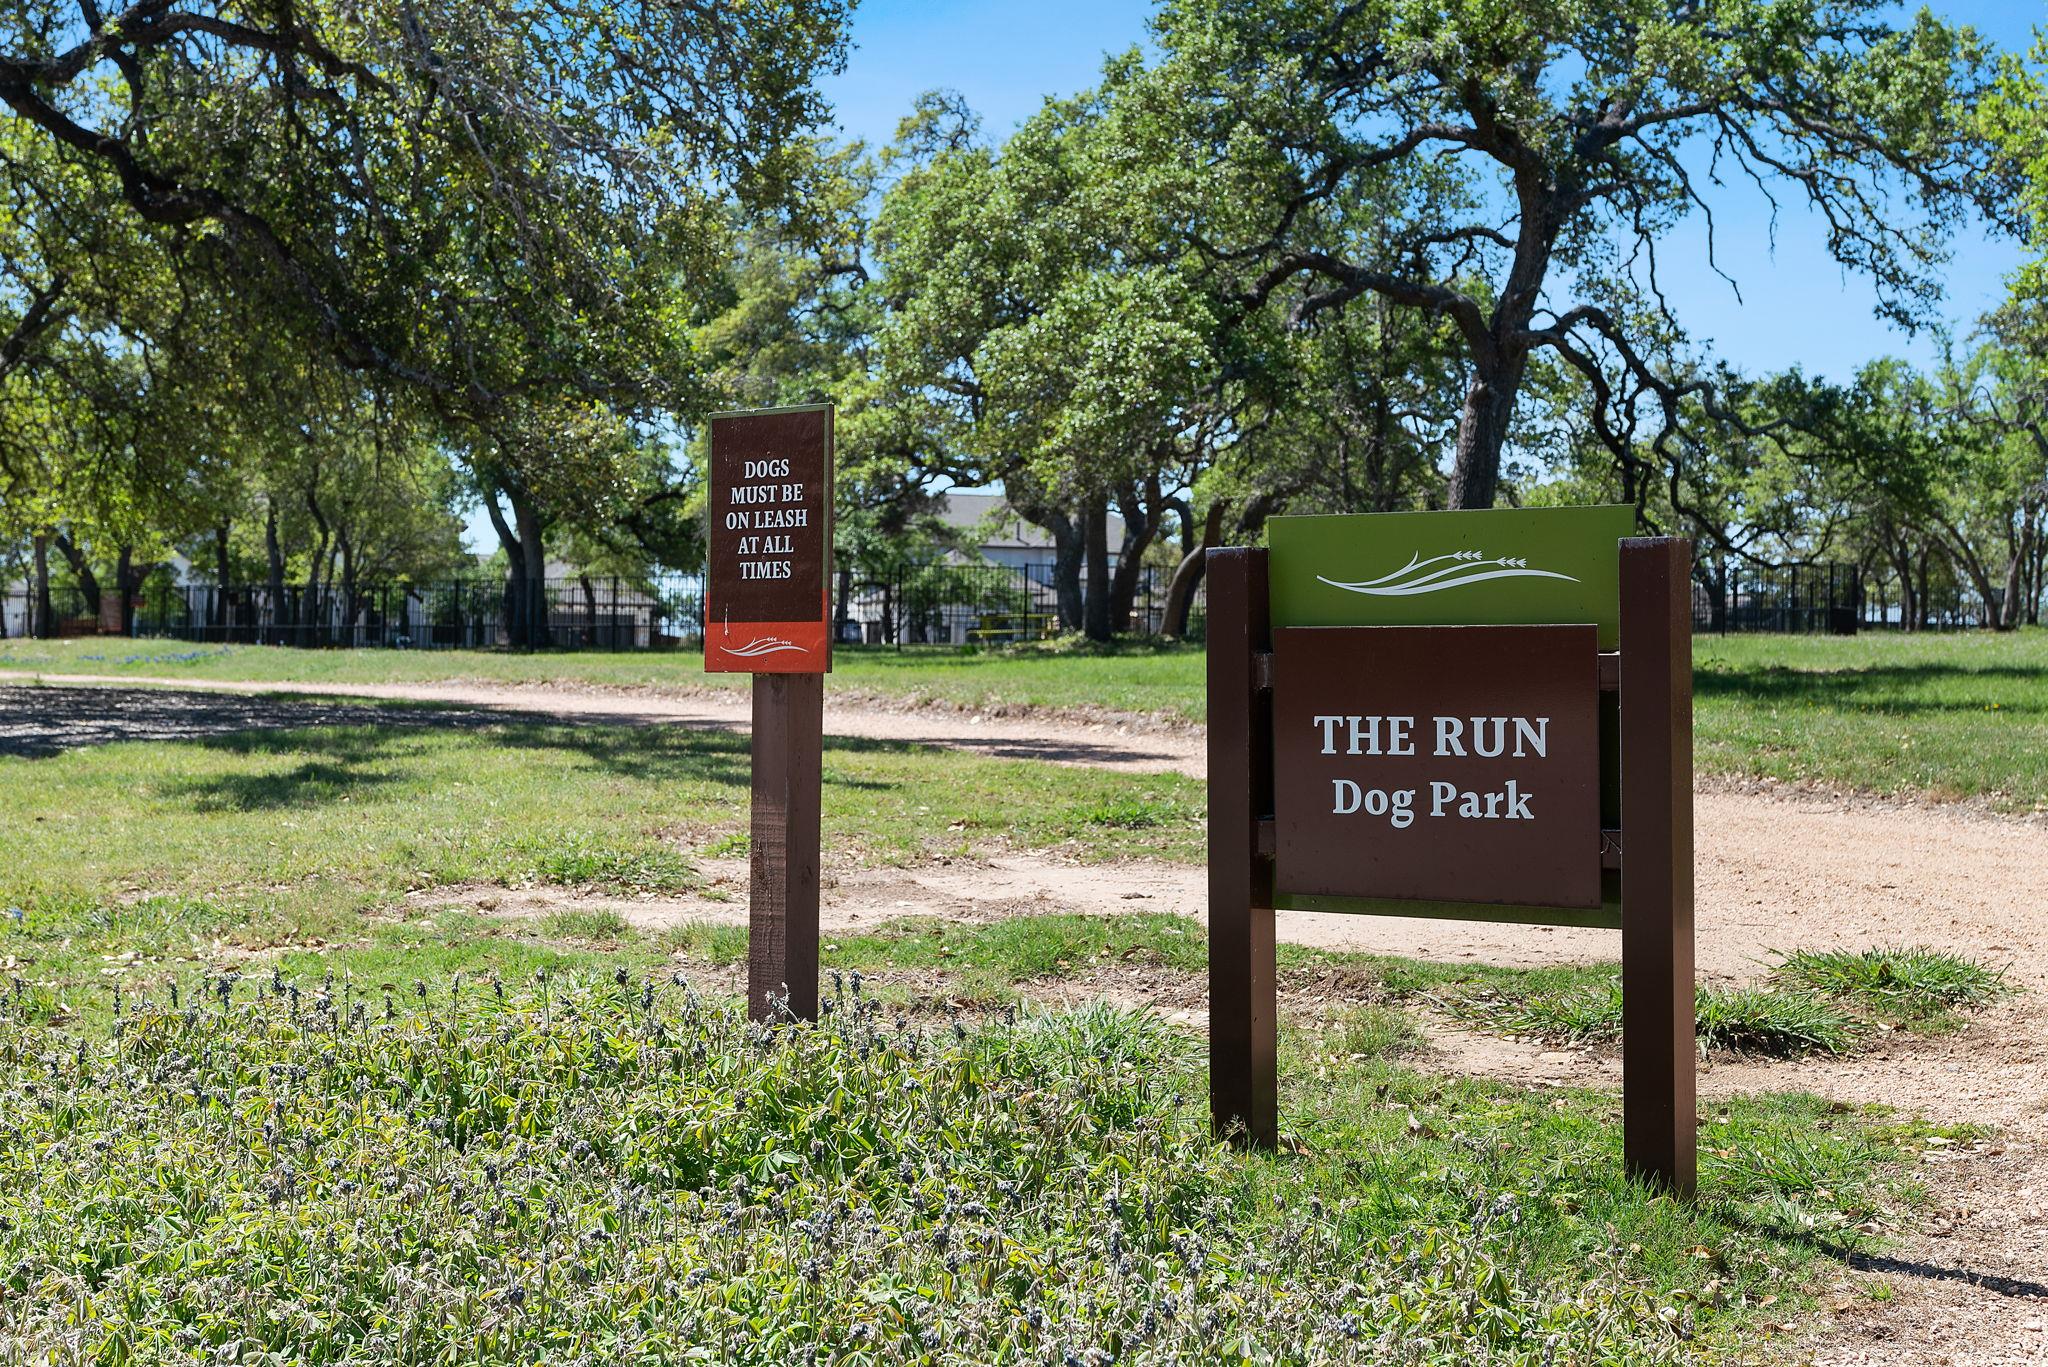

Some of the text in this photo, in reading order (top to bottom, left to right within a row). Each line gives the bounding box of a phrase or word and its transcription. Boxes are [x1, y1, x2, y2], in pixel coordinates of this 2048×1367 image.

[744, 458, 790, 479] DOGS
[731, 484, 803, 504] MUST BE
[725, 509, 808, 529] ON LEASH
[737, 535, 794, 554] AT ALL
[739, 560, 792, 580] TIMES
[1313, 715, 1550, 758] THE RUN
[1332, 779, 1535, 828] Dog Park
